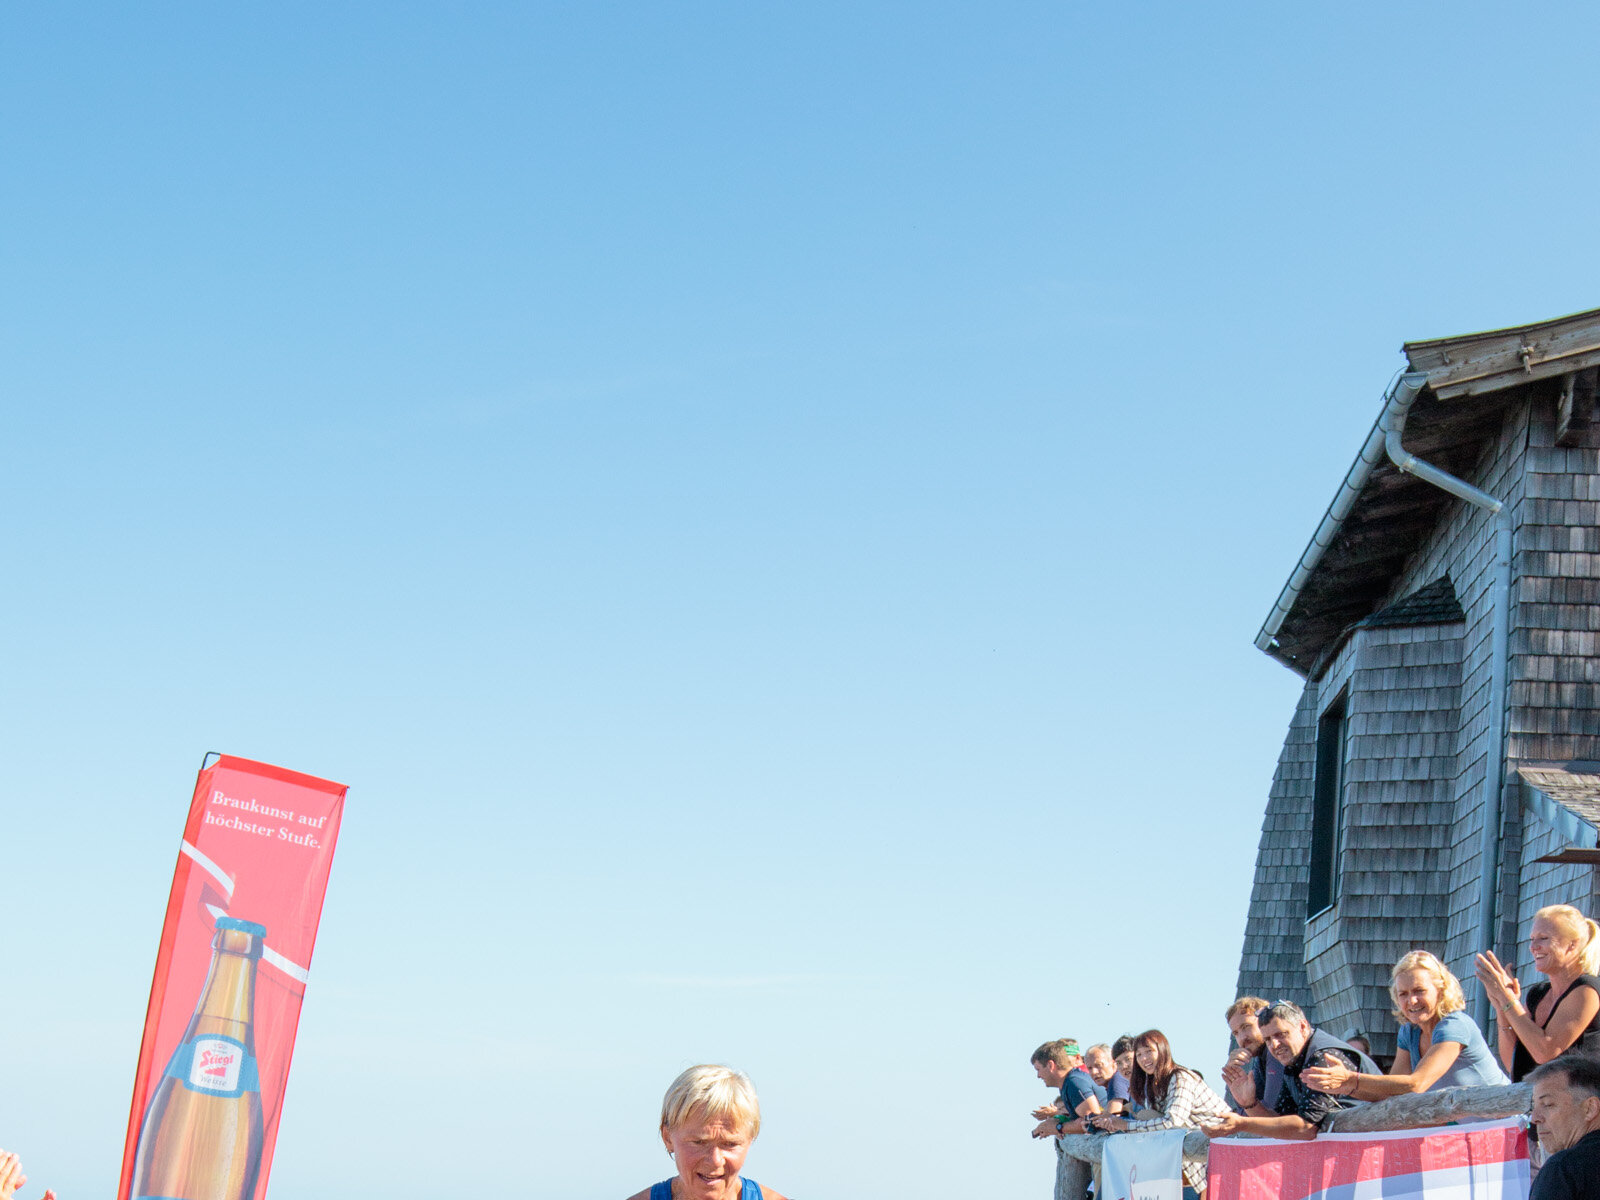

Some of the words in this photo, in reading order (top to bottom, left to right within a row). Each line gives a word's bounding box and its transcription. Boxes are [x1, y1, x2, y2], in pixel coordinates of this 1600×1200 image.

[205, 810, 275, 838] höchster
[277, 827, 322, 849] Stufe.
[211, 790, 295, 822] Braukunst
[298, 812, 327, 830] auf
[199, 1050, 234, 1068] Stiegl
